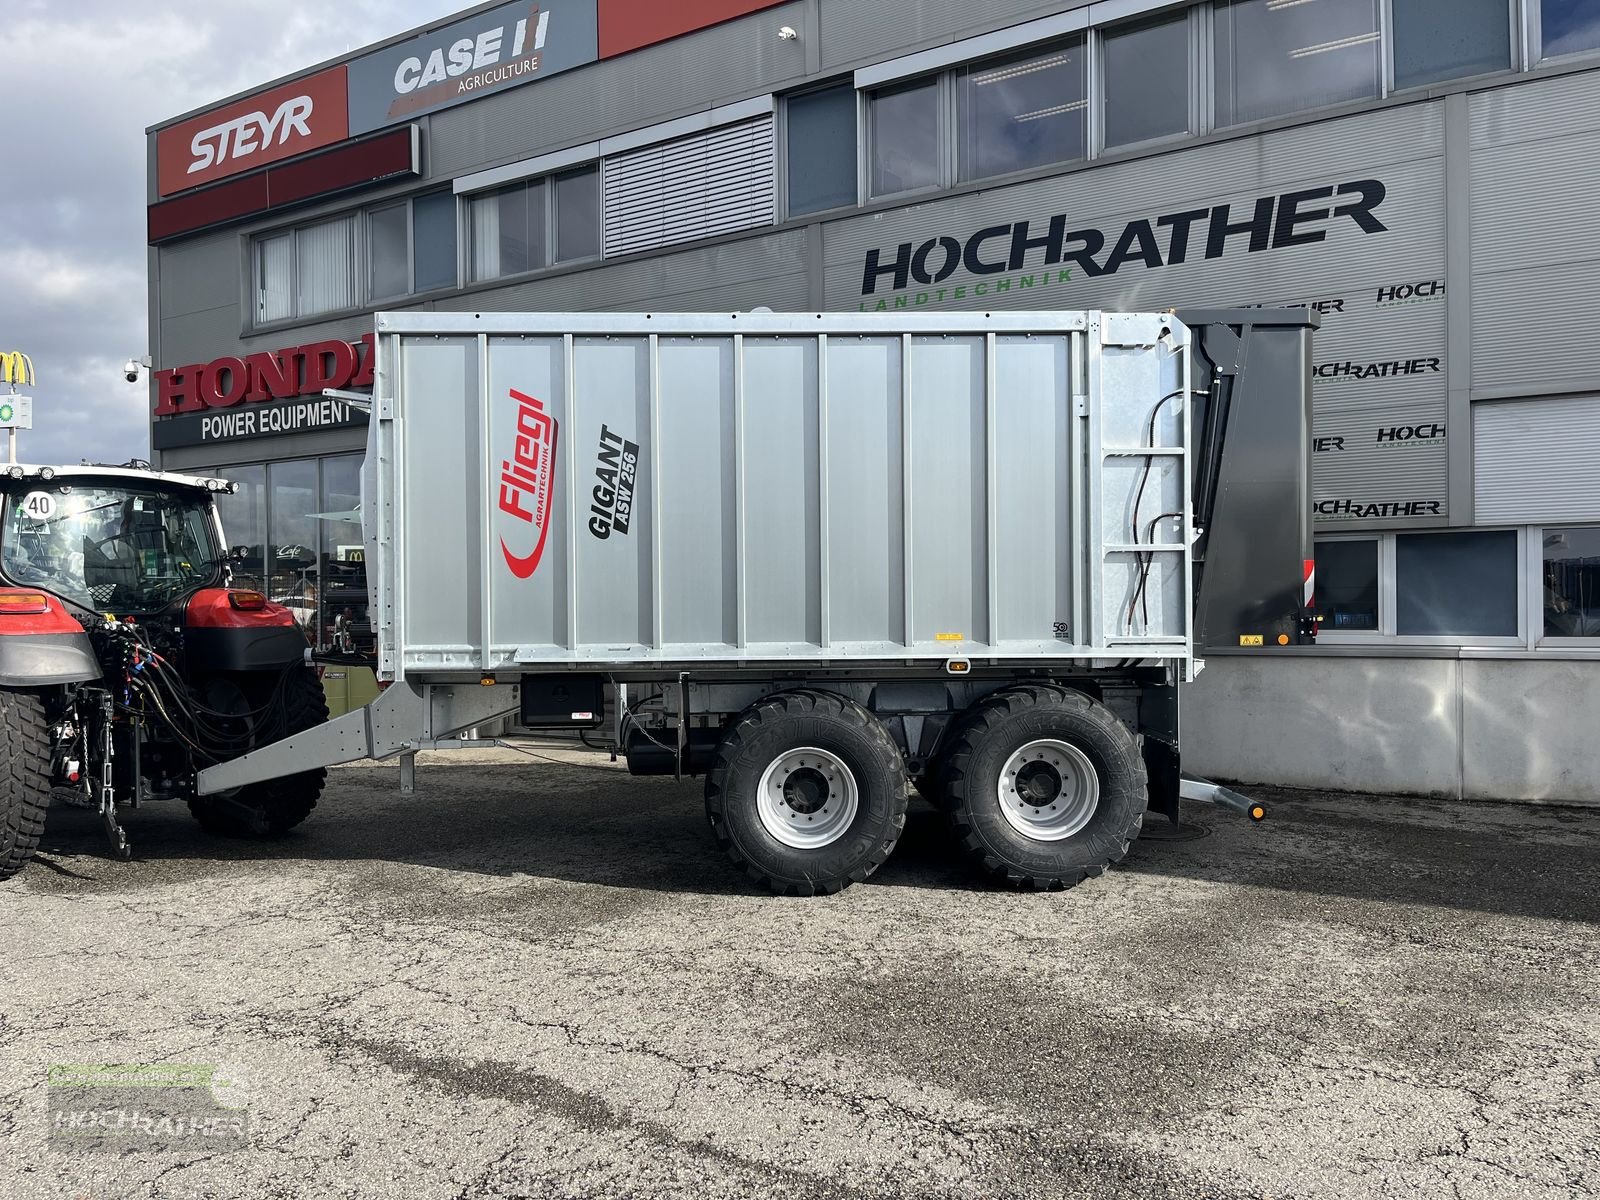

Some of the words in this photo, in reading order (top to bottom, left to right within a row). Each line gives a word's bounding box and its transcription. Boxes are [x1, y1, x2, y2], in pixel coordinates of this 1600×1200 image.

[394, 26, 504, 94] CASE
[457, 57, 538, 93] AGRICULTURE
[187, 95, 313, 174] STEYR
[861, 179, 1388, 296] HOCHRATHER
[859, 269, 1073, 312] LANDTECHNIK
[202, 411, 256, 439] POWER
[499, 388, 551, 523] Fliegl
[588, 424, 623, 540] GIGANT
[621, 451, 637, 486] 256
[29, 497, 49, 514] 40
[536, 447, 549, 528] AGRARTECHNIK
[615, 485, 632, 526] ASW
